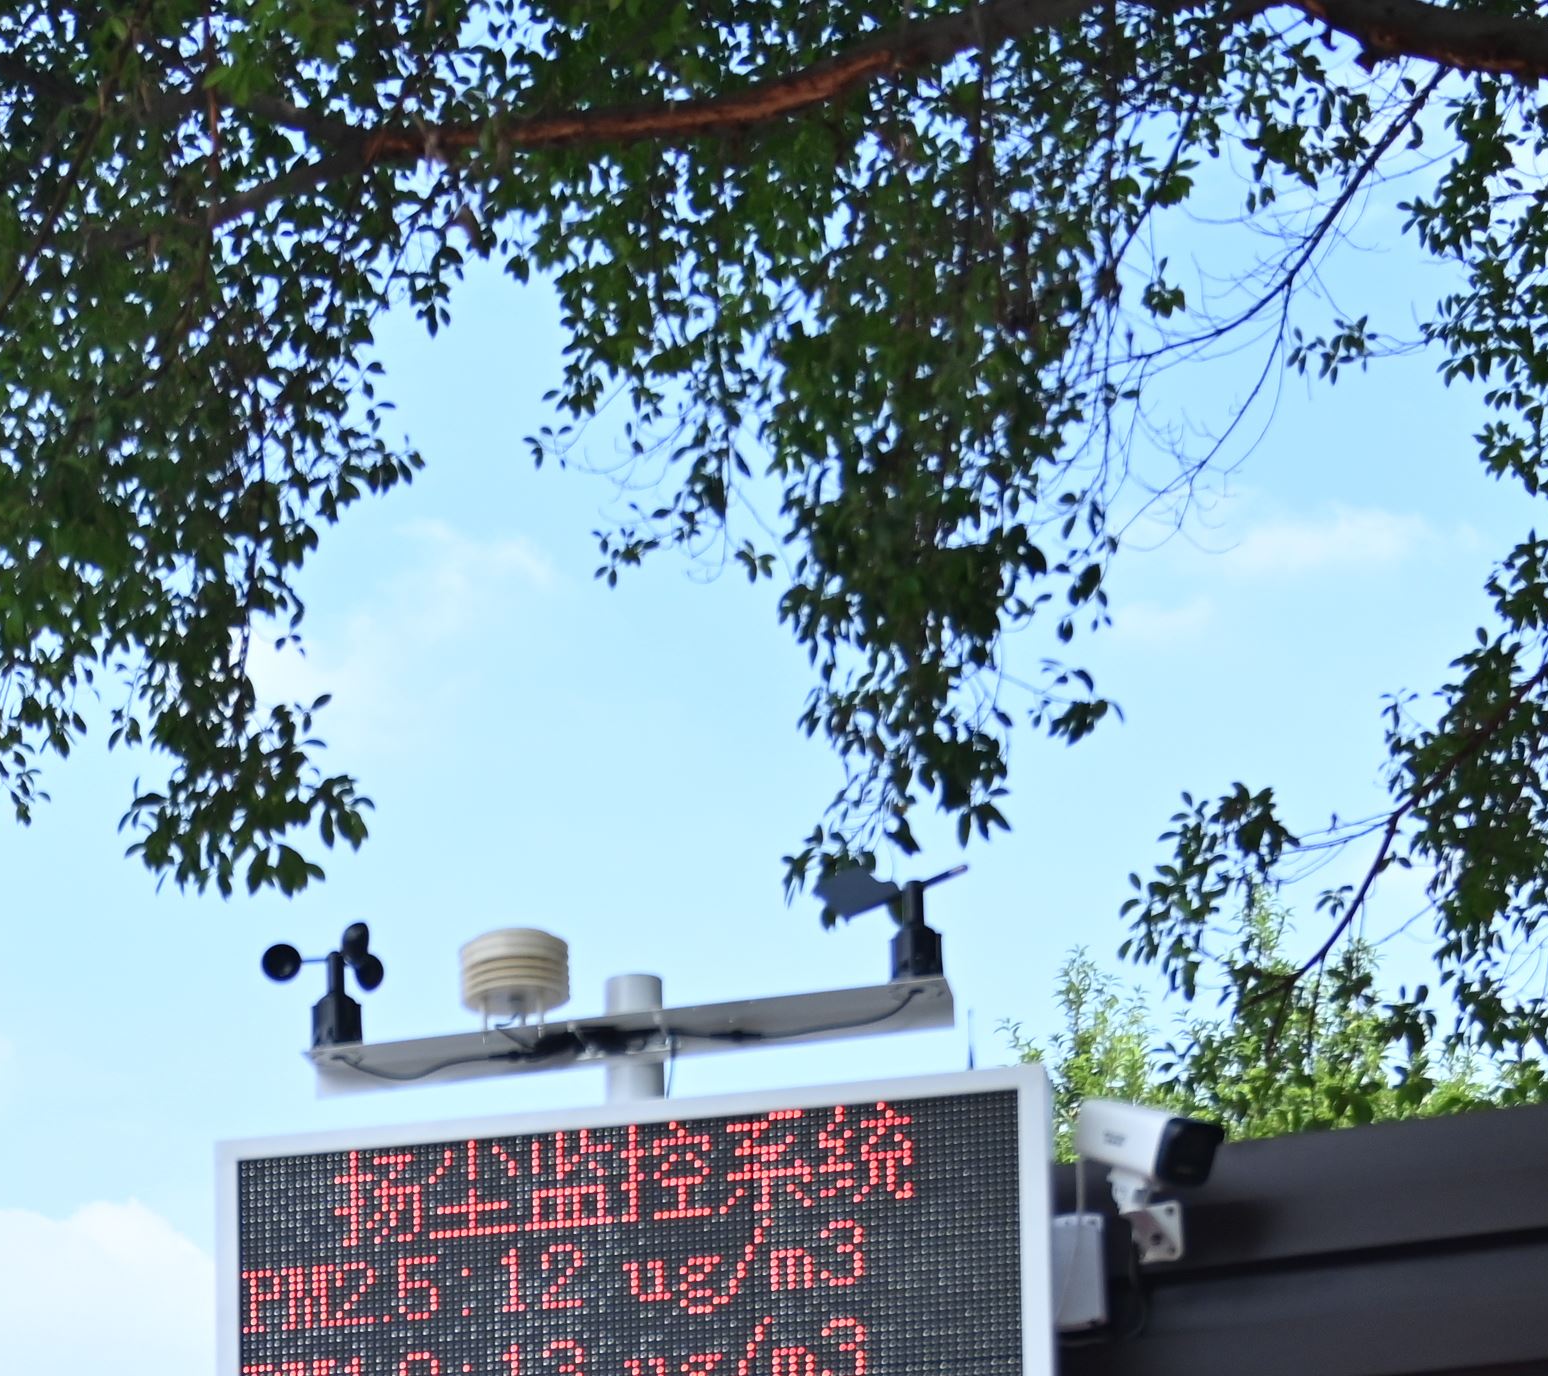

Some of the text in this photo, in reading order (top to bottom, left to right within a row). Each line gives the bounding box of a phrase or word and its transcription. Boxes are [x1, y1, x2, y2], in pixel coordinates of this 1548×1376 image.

[334, 1101, 916, 1247] 扬尘监控系统
[622, 1217, 867, 1316] ug/m3
